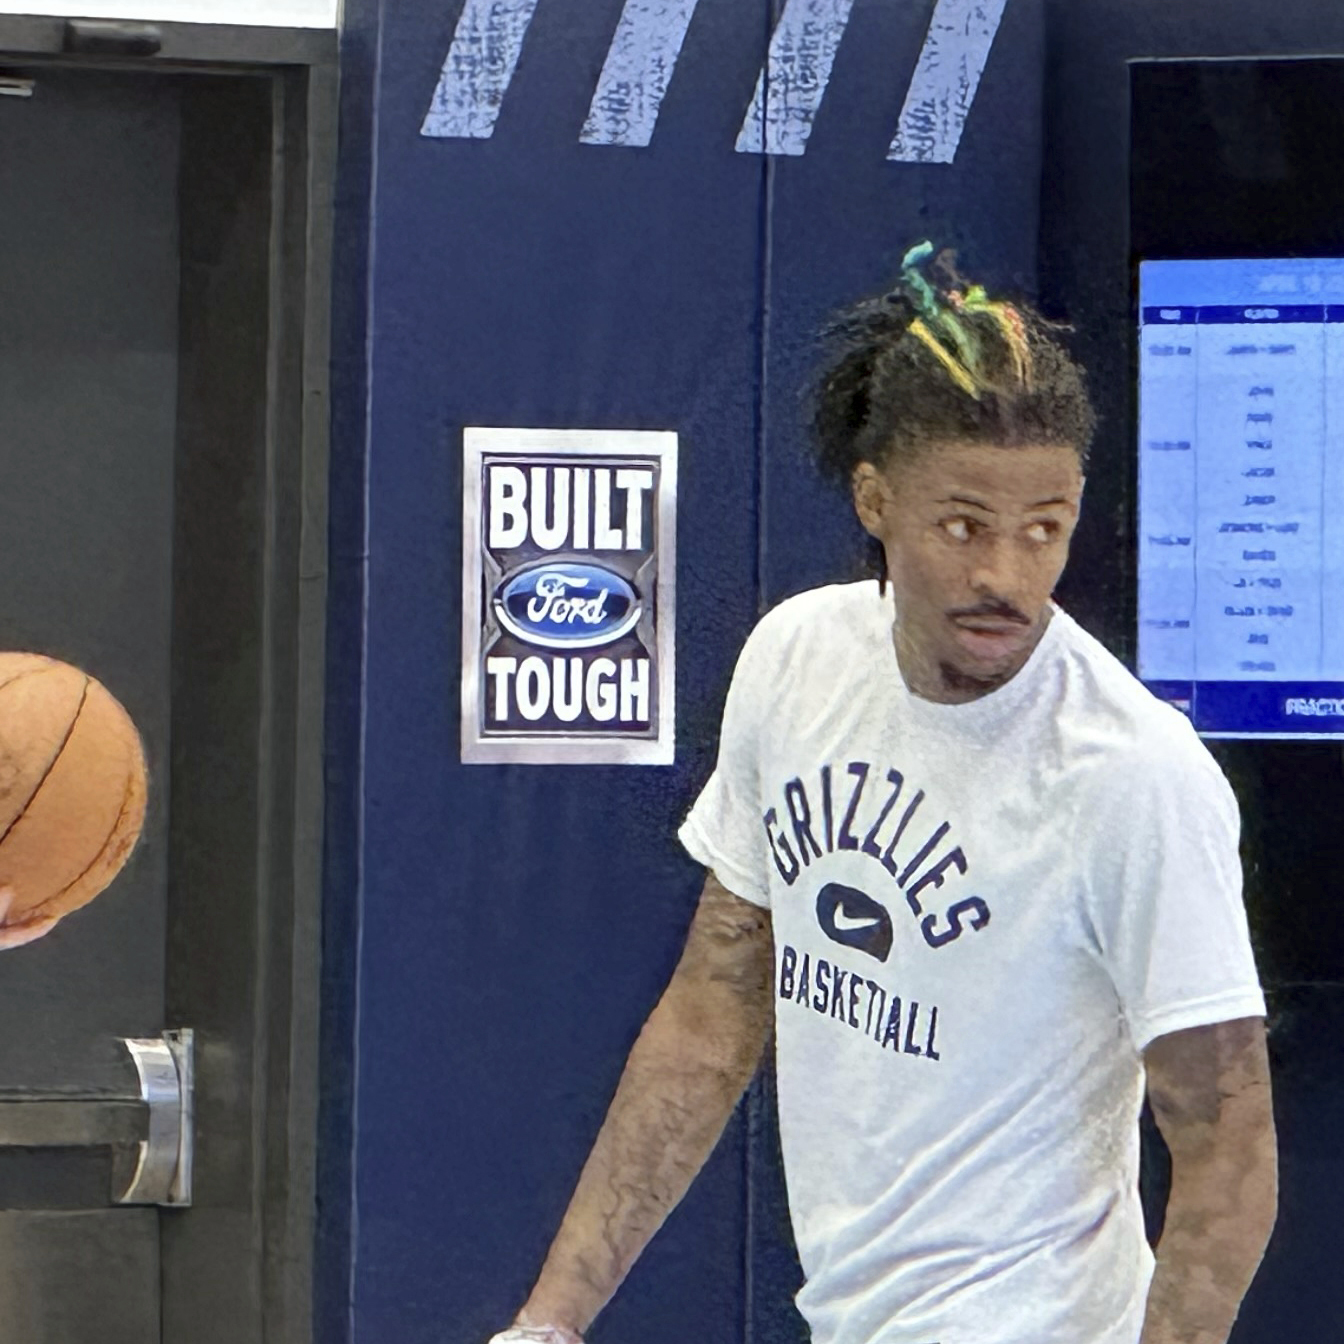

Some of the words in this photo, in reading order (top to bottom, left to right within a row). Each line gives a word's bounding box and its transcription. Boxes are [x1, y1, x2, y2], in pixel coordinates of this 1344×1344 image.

[489, 466, 653, 550] BUILT
[527, 573, 608, 625] Ford
[487, 656, 650, 722] TOUGH
[762, 761, 991, 949] GRIZZLIES
